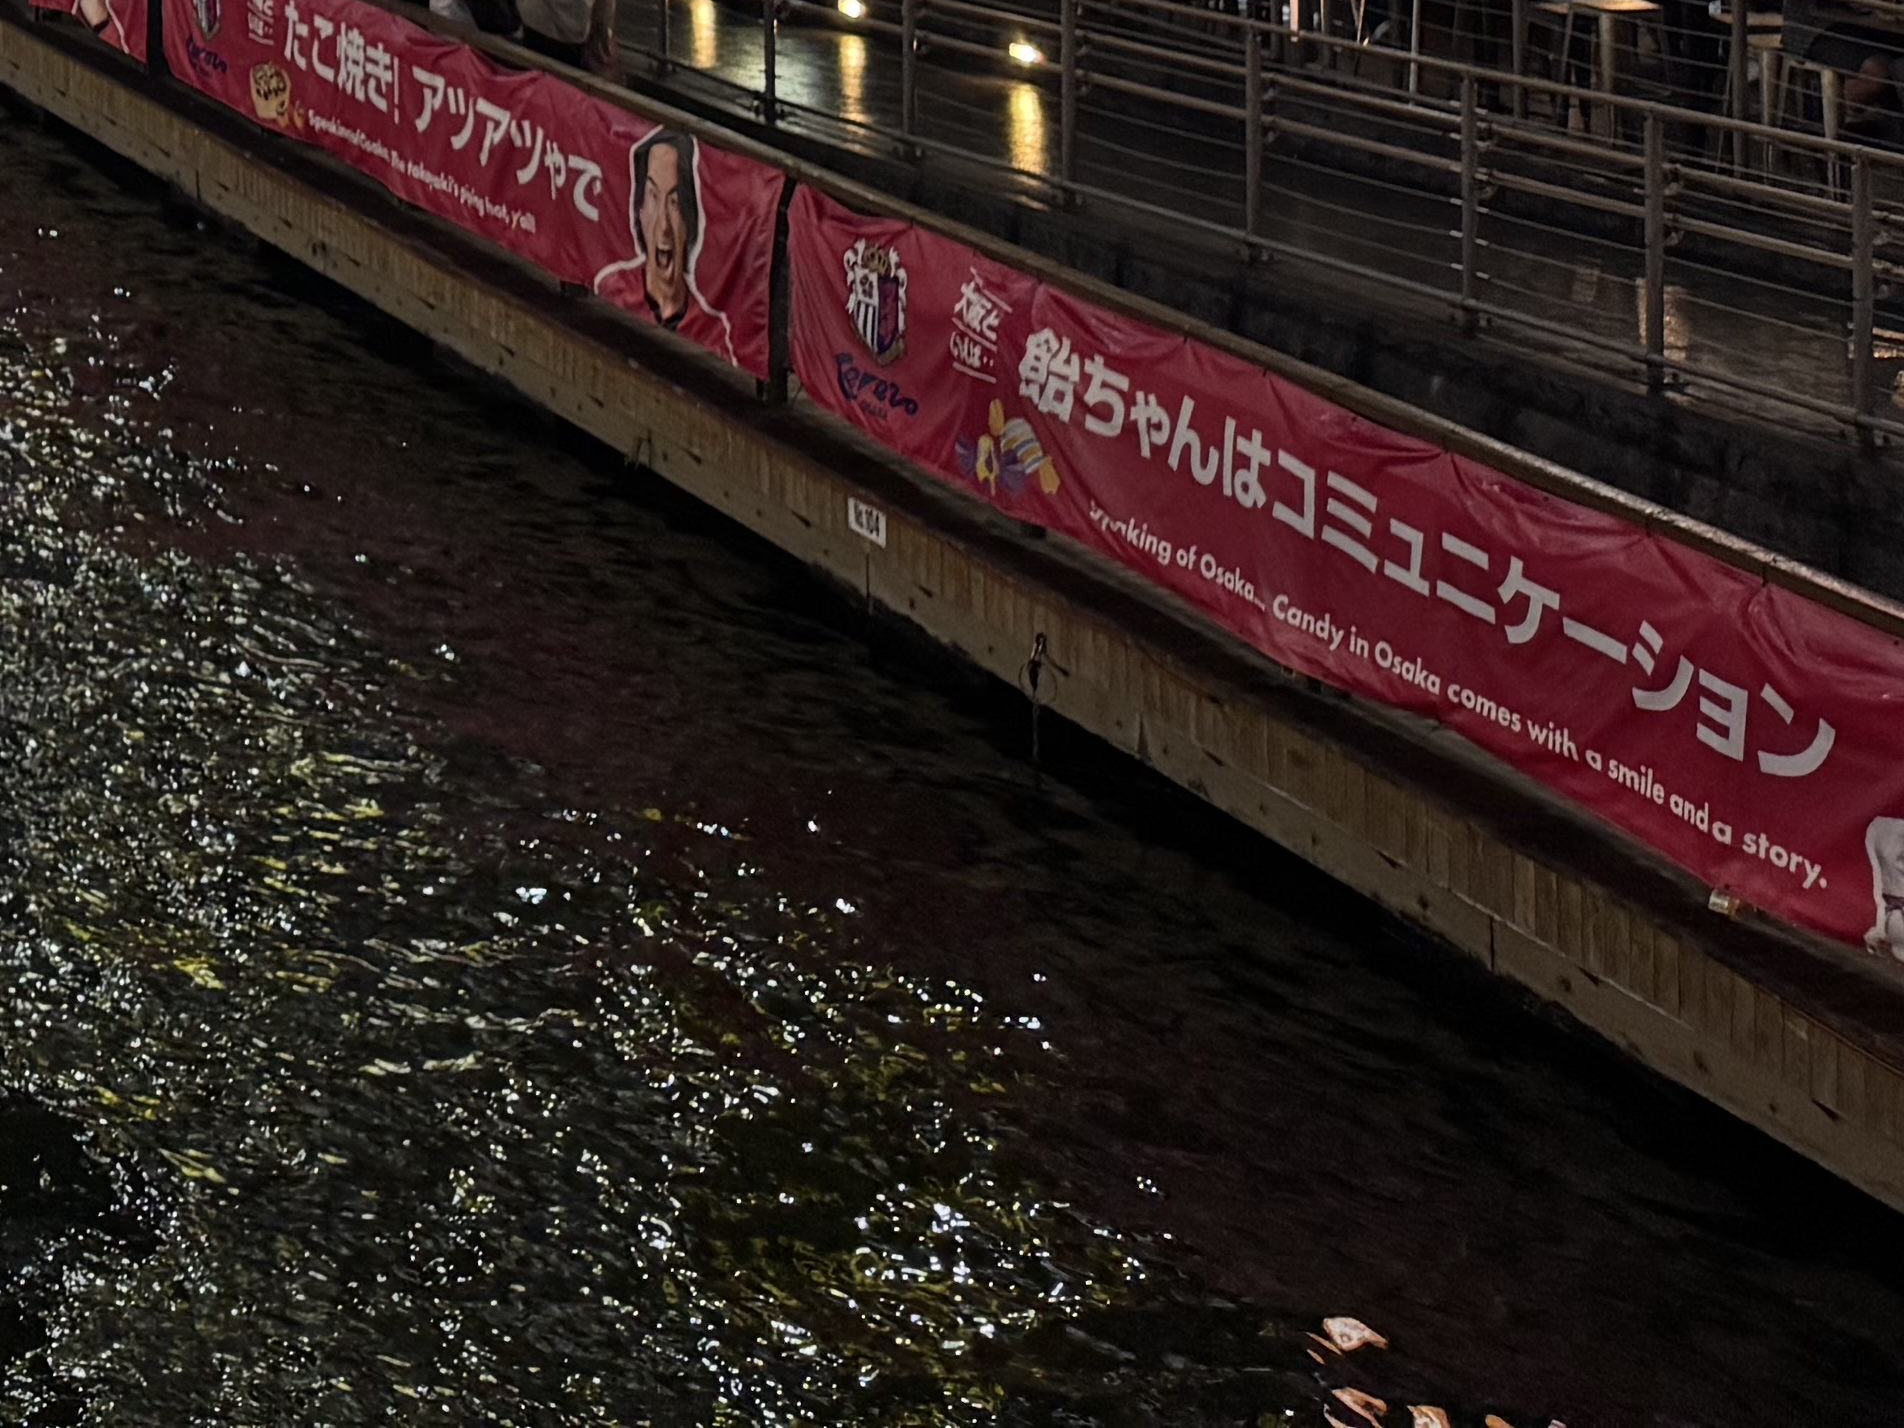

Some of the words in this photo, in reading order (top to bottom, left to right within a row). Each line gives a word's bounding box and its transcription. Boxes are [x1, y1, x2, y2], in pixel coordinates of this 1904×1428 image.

[1018, 327, 1837, 778] 飴ちゃんはコミュニケーション
[1176, 542, 1197, 569] of
[1273, 593, 1344, 652] Candy
[1349, 626, 1370, 660] in
[1374, 640, 1441, 696] Osaka
[1447, 682, 1522, 733] comes
[1527, 717, 1581, 761] with
[1585, 749, 1604, 772] a
[1607, 756, 1665, 806] smile
[1670, 793, 1710, 833] and
[1712, 817, 1733, 845] a
[1742, 828, 1829, 890] story.
